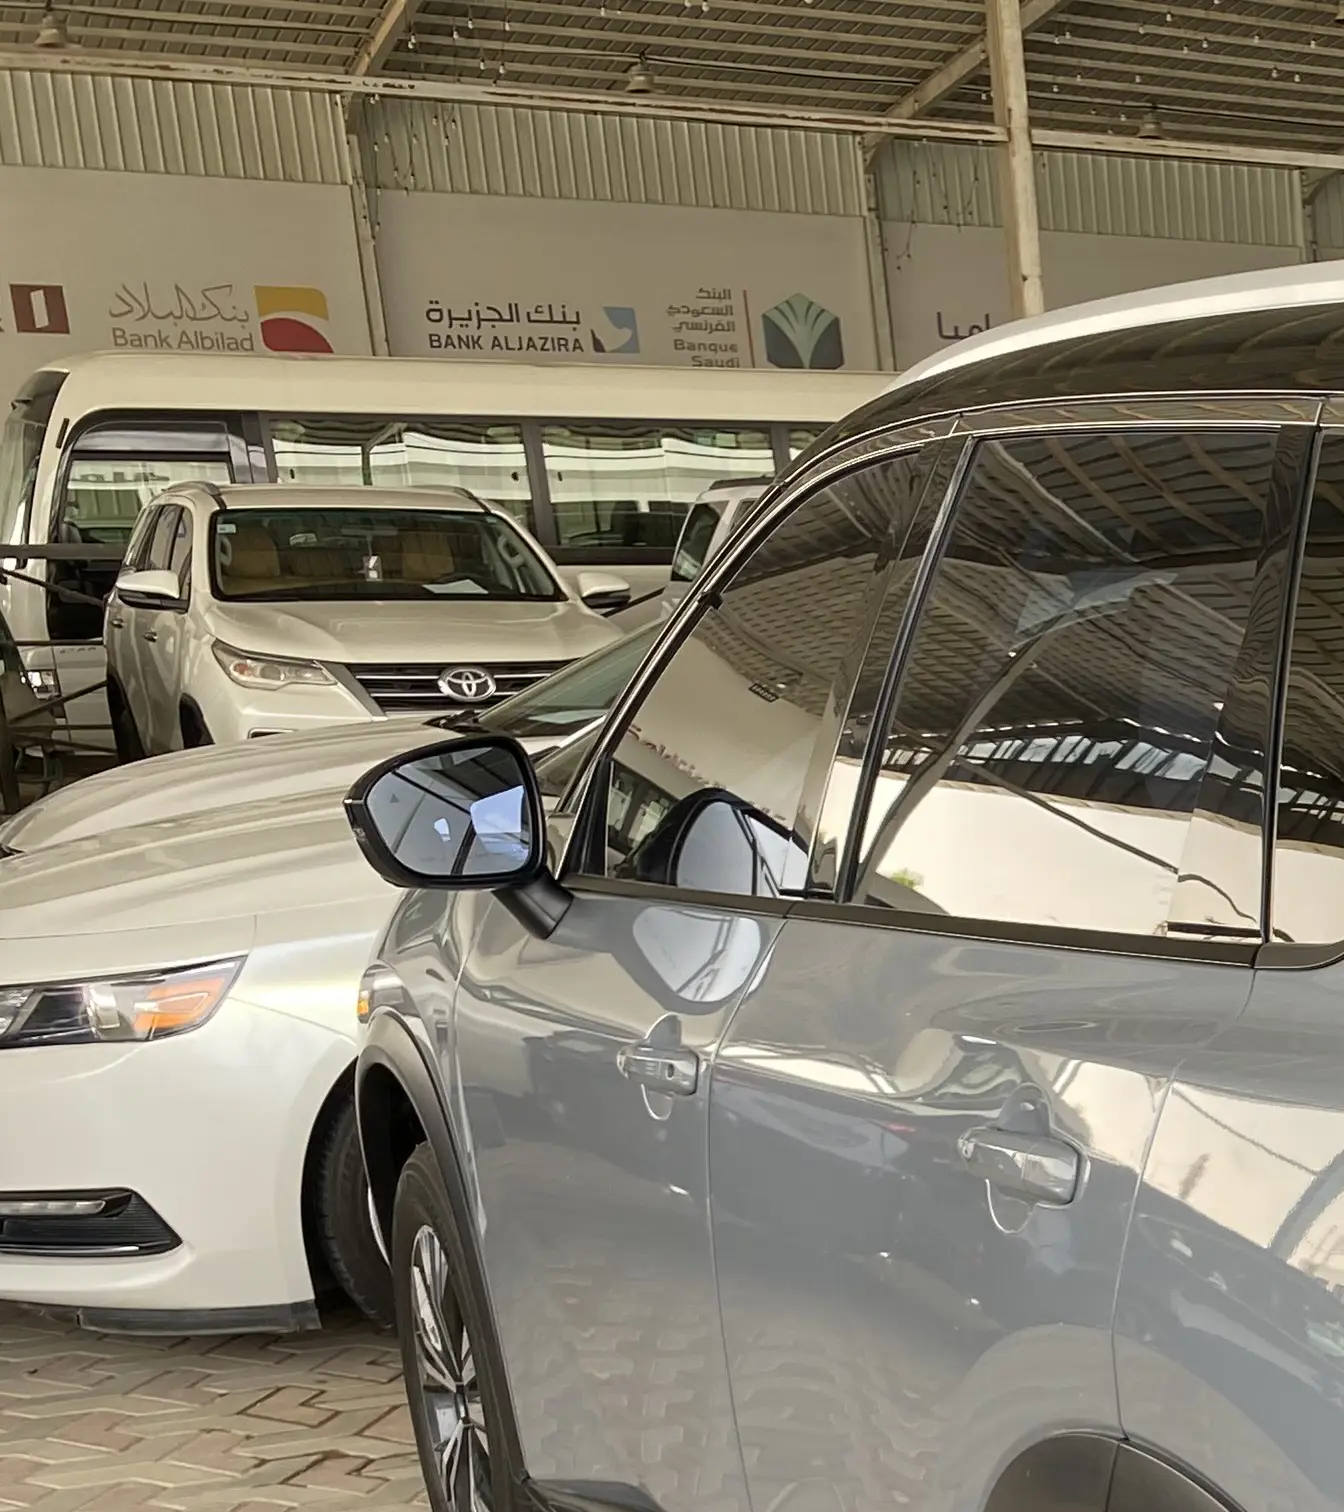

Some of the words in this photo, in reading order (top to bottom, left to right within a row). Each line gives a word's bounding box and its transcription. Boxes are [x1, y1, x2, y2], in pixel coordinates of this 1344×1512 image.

[695, 287, 732, 303] البنك
[425, 299, 521, 331] الجزيرة
[526, 303, 581, 332] بنك
[665, 304, 734, 318] السعودي
[669, 319, 736, 335] الفرنسي
[111, 326, 174, 349] Bank
[176, 331, 256, 352] Albilad
[428, 333, 485, 351] BANK
[490, 334, 585, 353] ALJAZIRA
[673, 338, 739, 354] Banque
[690, 355, 741, 369] Saudi
